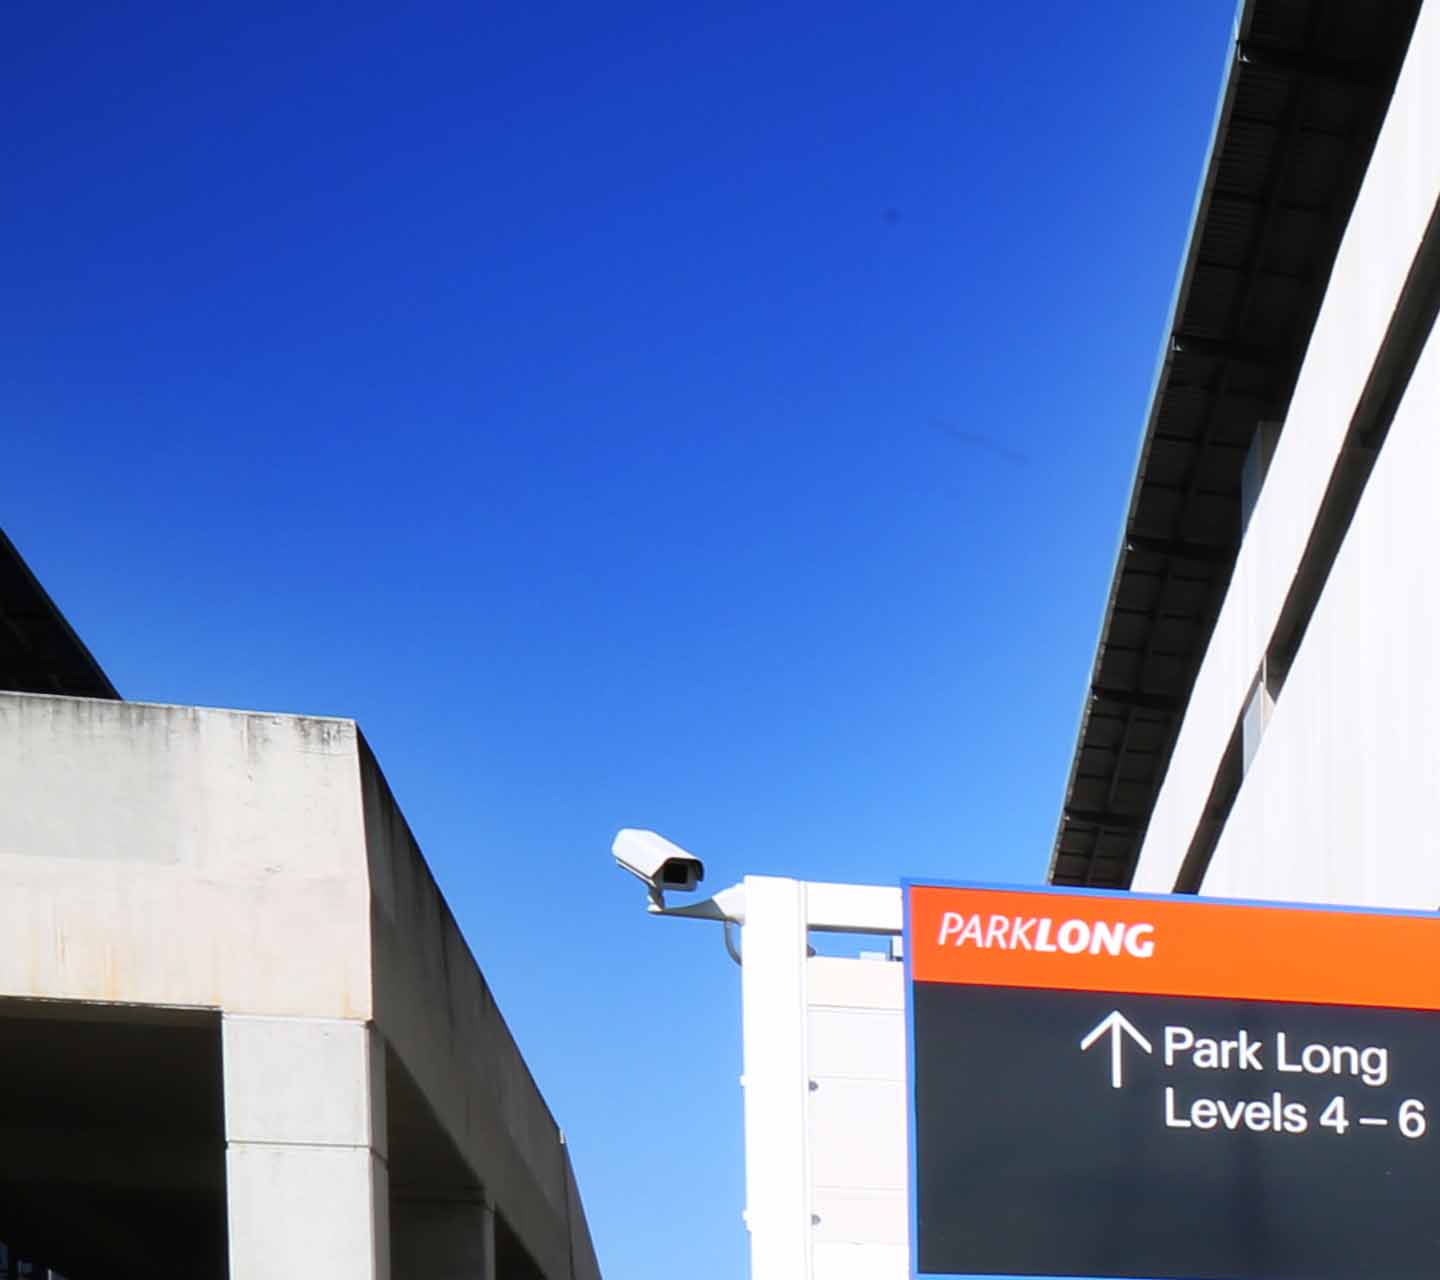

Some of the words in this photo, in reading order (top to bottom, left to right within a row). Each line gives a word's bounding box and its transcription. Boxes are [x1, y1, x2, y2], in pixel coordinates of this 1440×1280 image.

[938, 911, 1154, 958] PARKLONG
[1164, 1026, 1263, 1071] Park
[1277, 1032, 1389, 1087] Long
[1164, 1087, 1308, 1133] Levels
[1320, 1096, 1349, 1135] 4
[1398, 1100, 1426, 1138] 6
